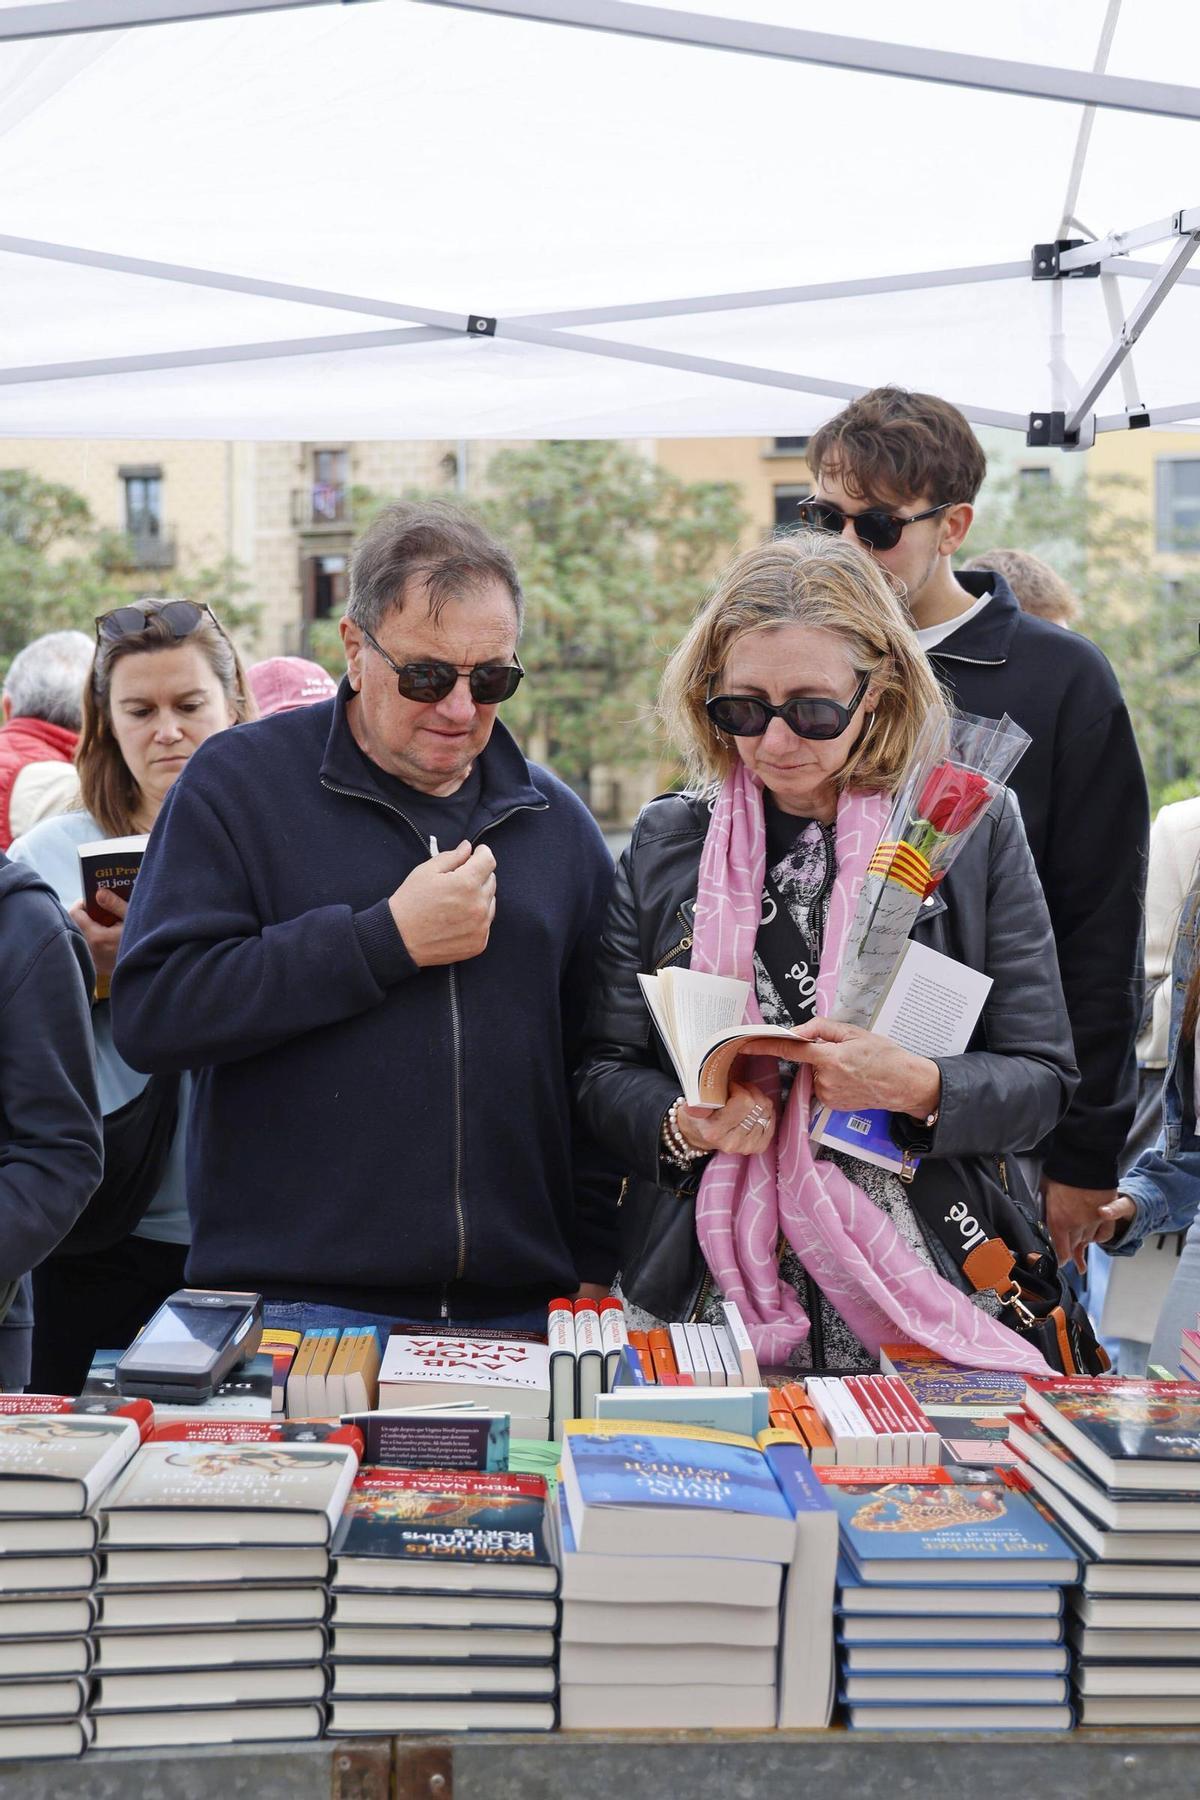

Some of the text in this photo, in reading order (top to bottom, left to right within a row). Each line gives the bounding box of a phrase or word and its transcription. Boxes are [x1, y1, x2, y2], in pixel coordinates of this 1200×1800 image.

[95, 866, 140, 878] Gil Prat
[111, 879, 130, 889] joc
[944, 1202, 989, 1251] loé
[409, 1341, 526, 1354] MAMA
[404, 1349, 529, 1363] AMOR,
[423, 1360, 507, 1371] AMB
[409, 1481, 468, 1489] NADAL
